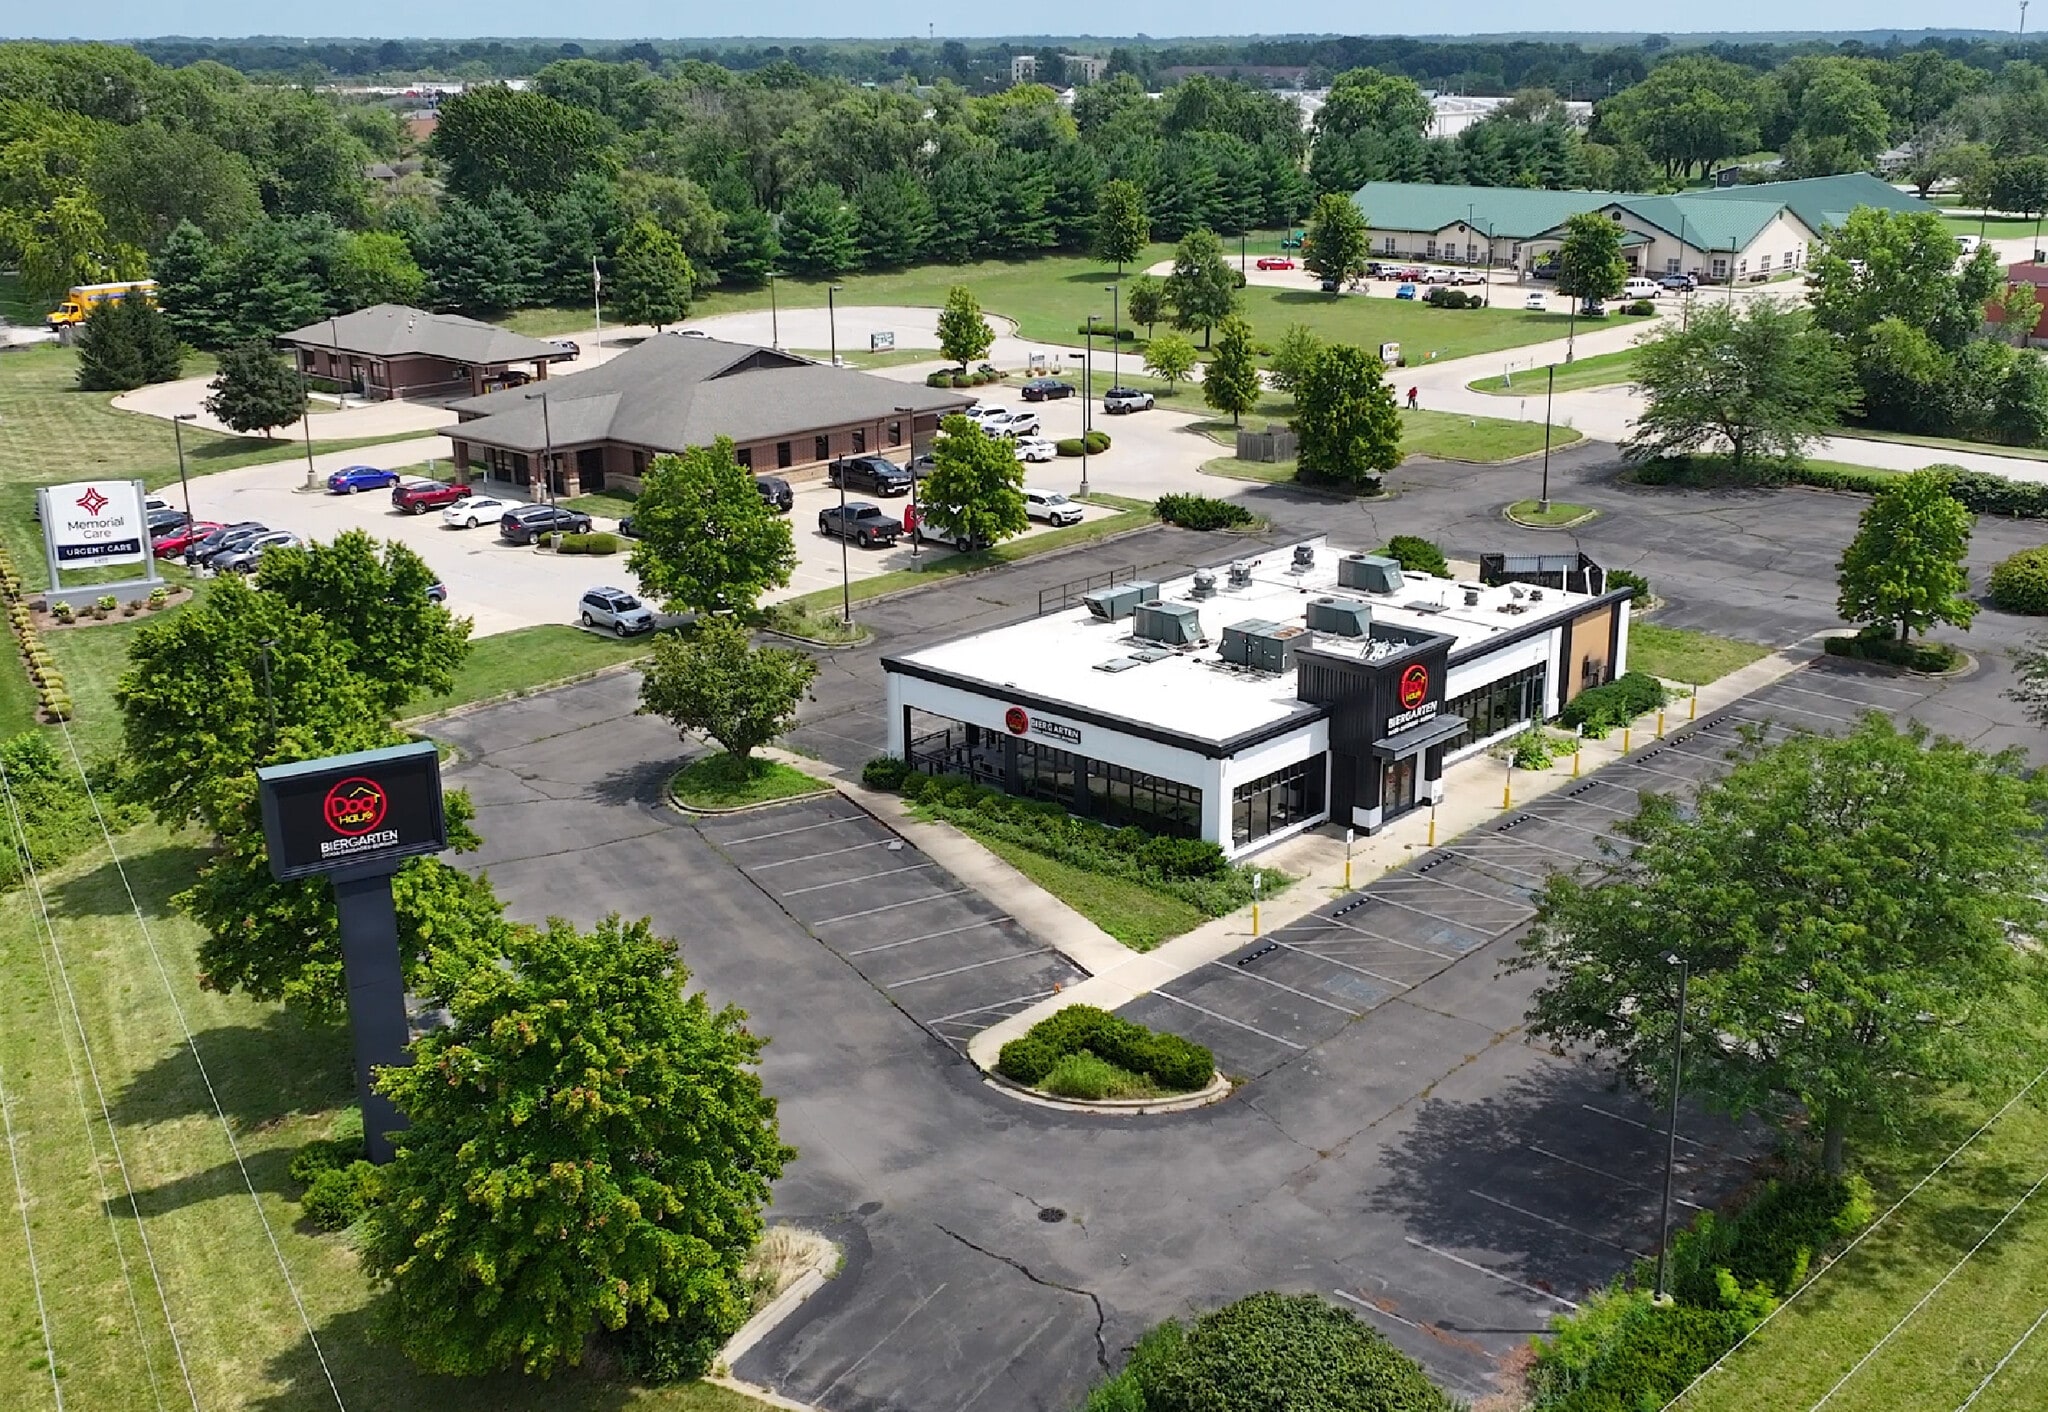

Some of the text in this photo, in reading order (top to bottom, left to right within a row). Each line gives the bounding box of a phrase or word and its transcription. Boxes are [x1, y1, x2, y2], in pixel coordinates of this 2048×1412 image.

[68, 517, 124, 531] Memorial
[83, 529, 112, 539] Care
[66, 543, 132, 556] URGENT CARE
[1388, 701, 1437, 728] BIERGARTEN
[1031, 718, 1079, 738] BIERGARTEN
[320, 830, 398, 853] BIERGARTEN
